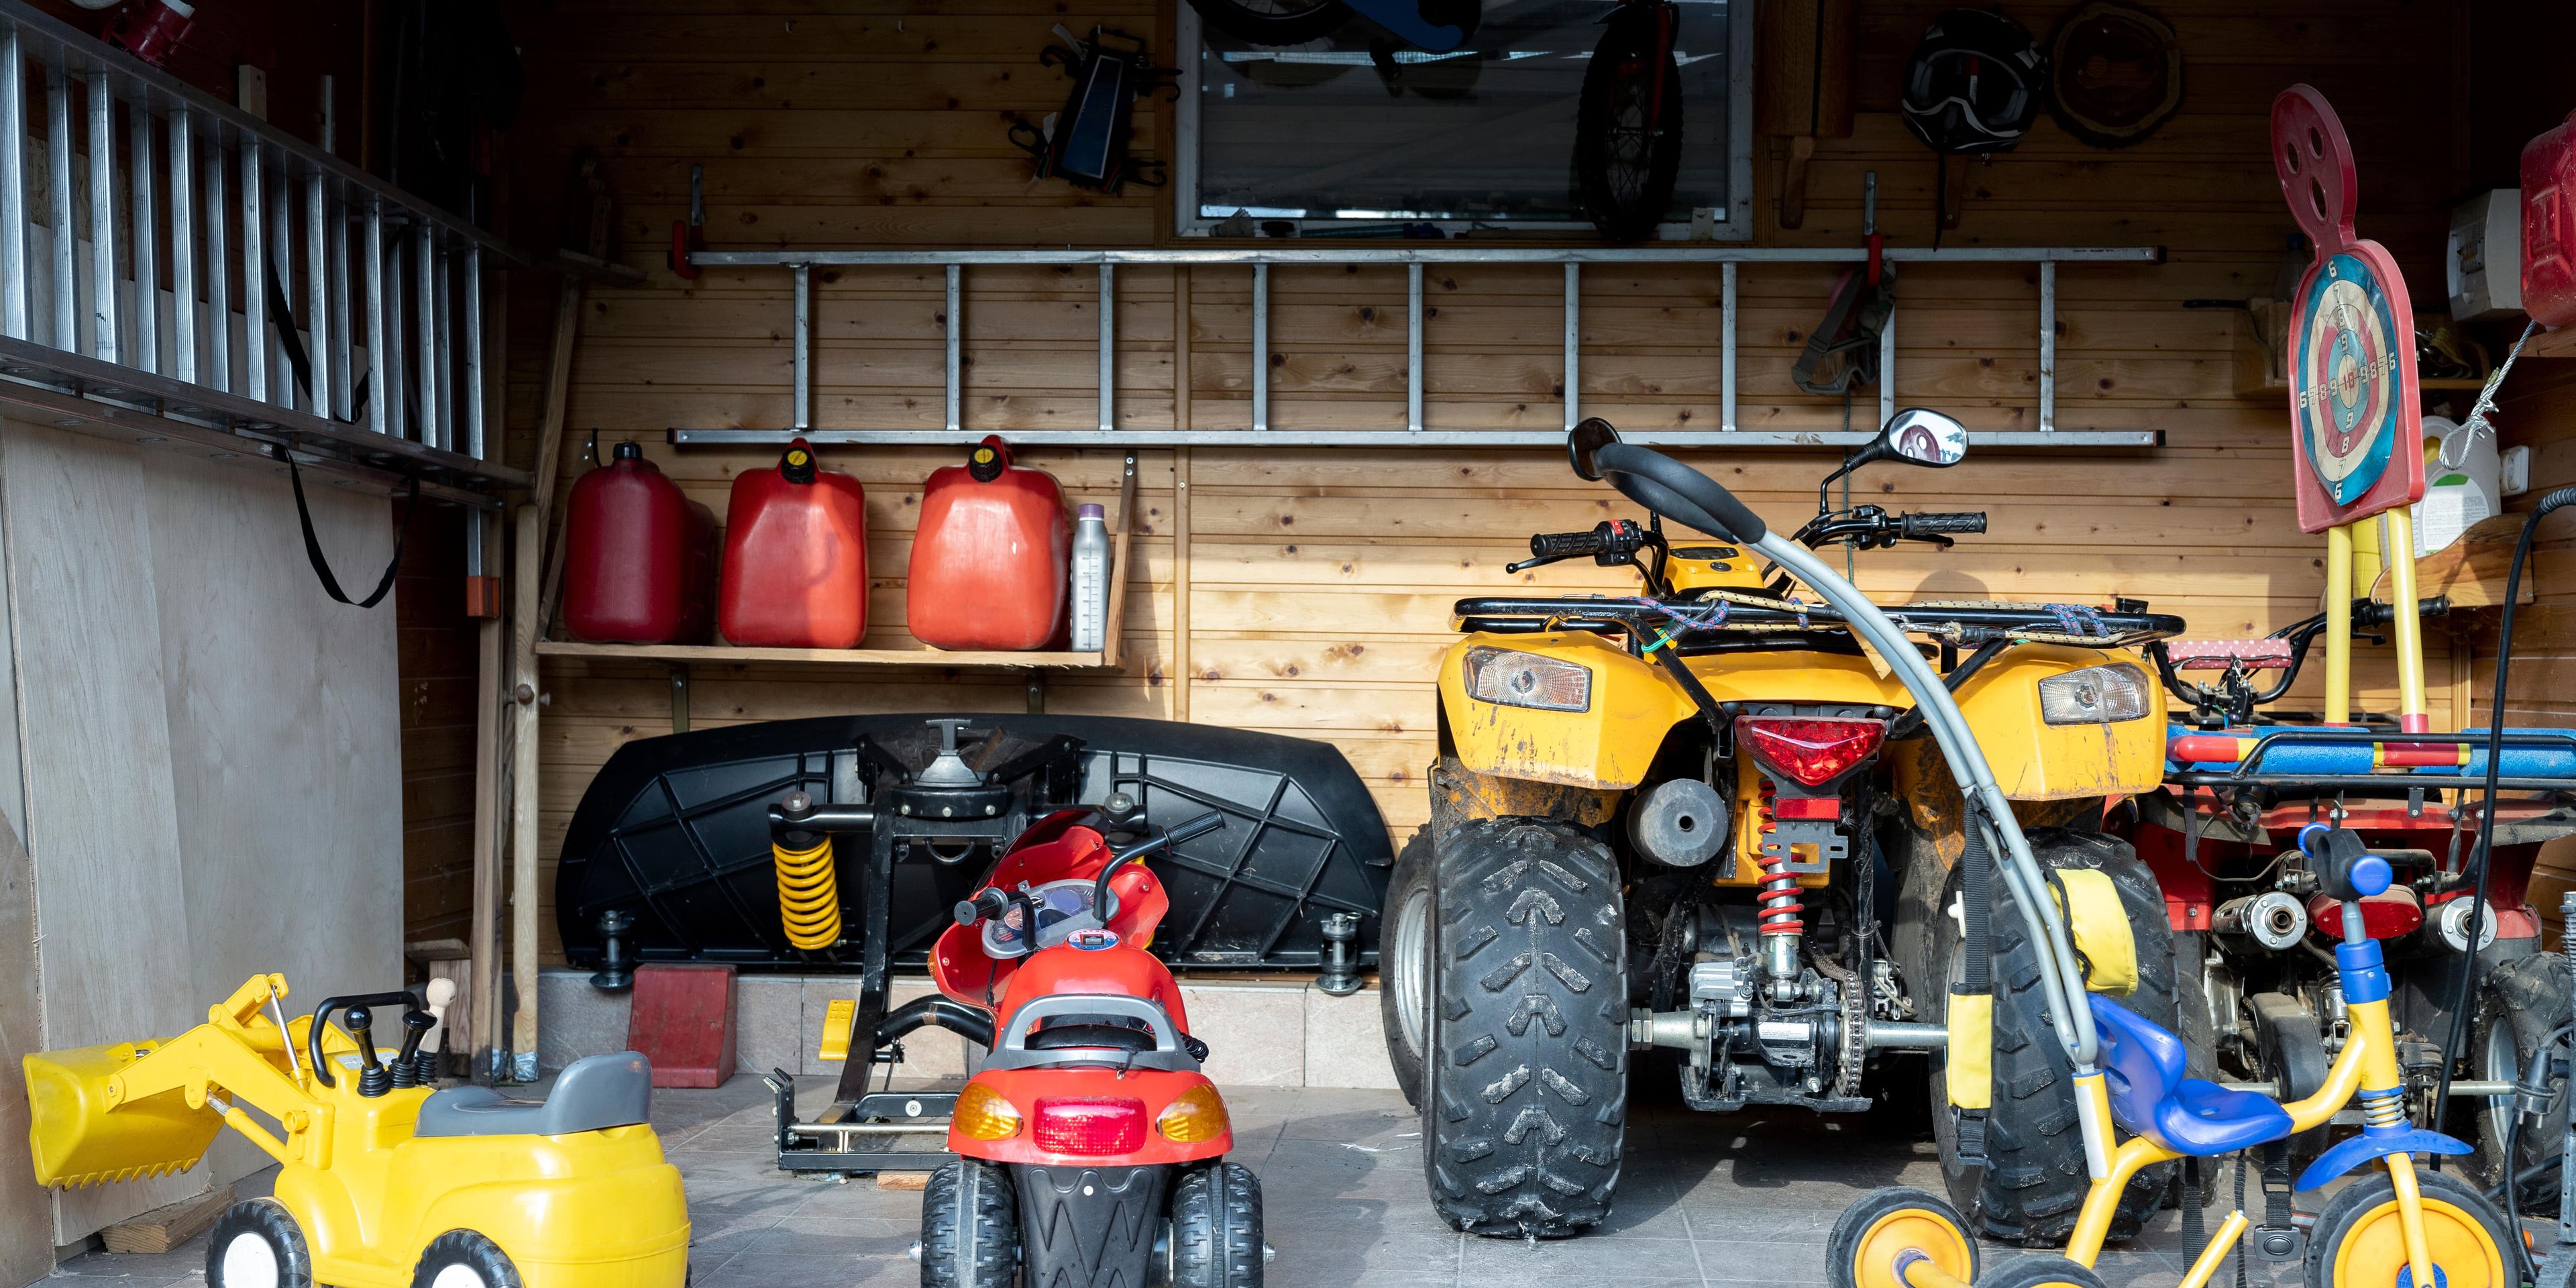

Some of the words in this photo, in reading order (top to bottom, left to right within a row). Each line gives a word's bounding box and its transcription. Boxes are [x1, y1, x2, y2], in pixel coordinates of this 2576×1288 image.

[2328, 260, 2337, 277] 6
[2333, 284, 2340, 302] 7
[2338, 309, 2345, 326] 8
[2341, 333, 2348, 352] 9
[2299, 391, 2307, 408] 6
[2309, 387, 2316, 405] 7
[2319, 383, 2326, 400] 8
[2329, 379, 2338, 396] 9
[2344, 372, 2354, 390] 10
[2360, 366, 2368, 384] 9
[2370, 362, 2377, 379] 8
[2379, 356, 2386, 375] 7
[2389, 353, 2395, 370] 6
[2346, 411, 2354, 429] 9
[2342, 436, 2350, 453] 8
[2338, 460, 2346, 477] 7
[2335, 483, 2342, 500] 6
